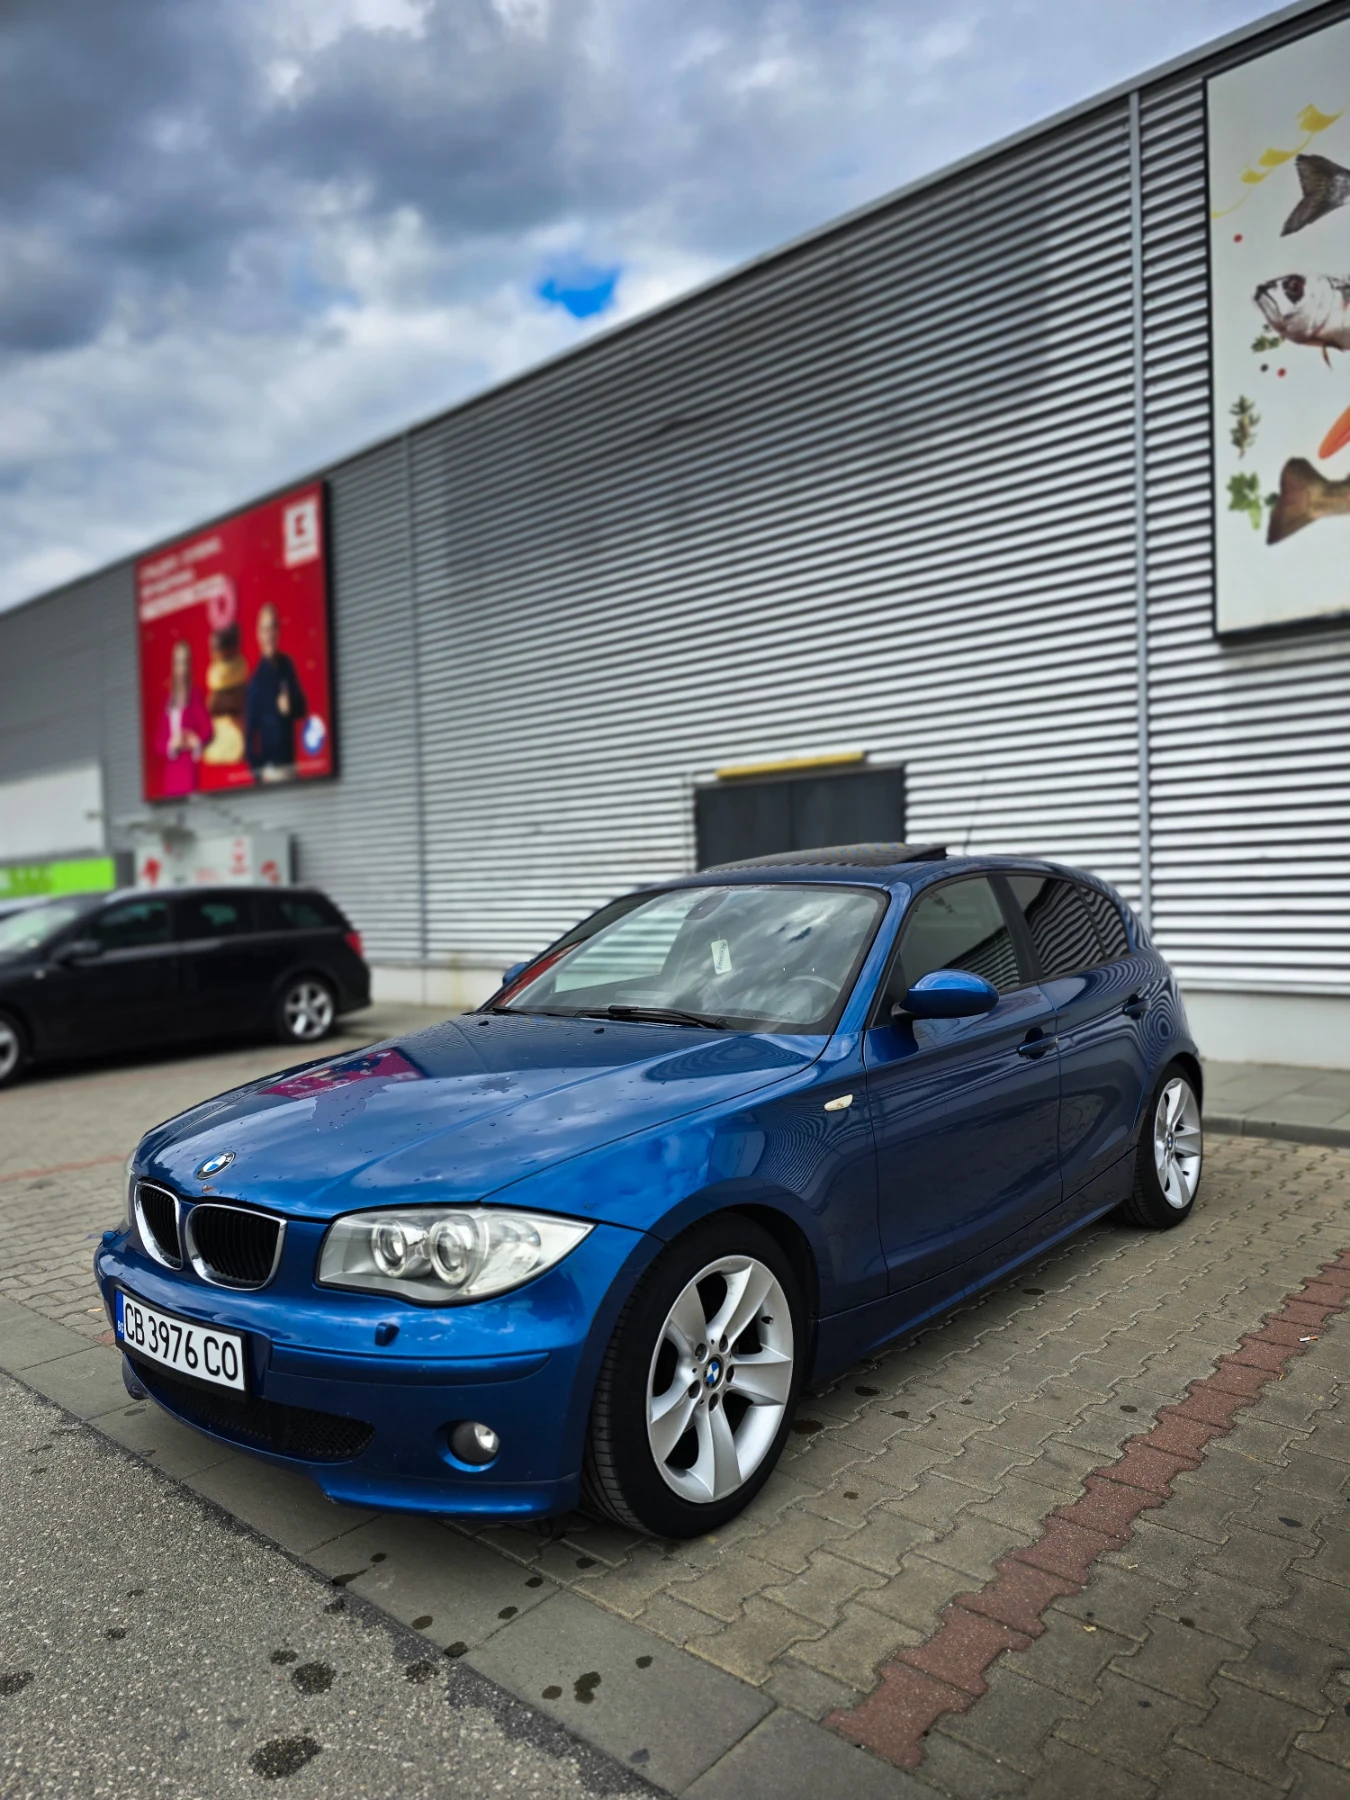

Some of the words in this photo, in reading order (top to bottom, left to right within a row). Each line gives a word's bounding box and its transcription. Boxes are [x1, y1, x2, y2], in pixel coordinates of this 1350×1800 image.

[125, 1303, 145, 1346] CB
[148, 1315, 198, 1369] 3976
[204, 1336, 238, 1381] CO
